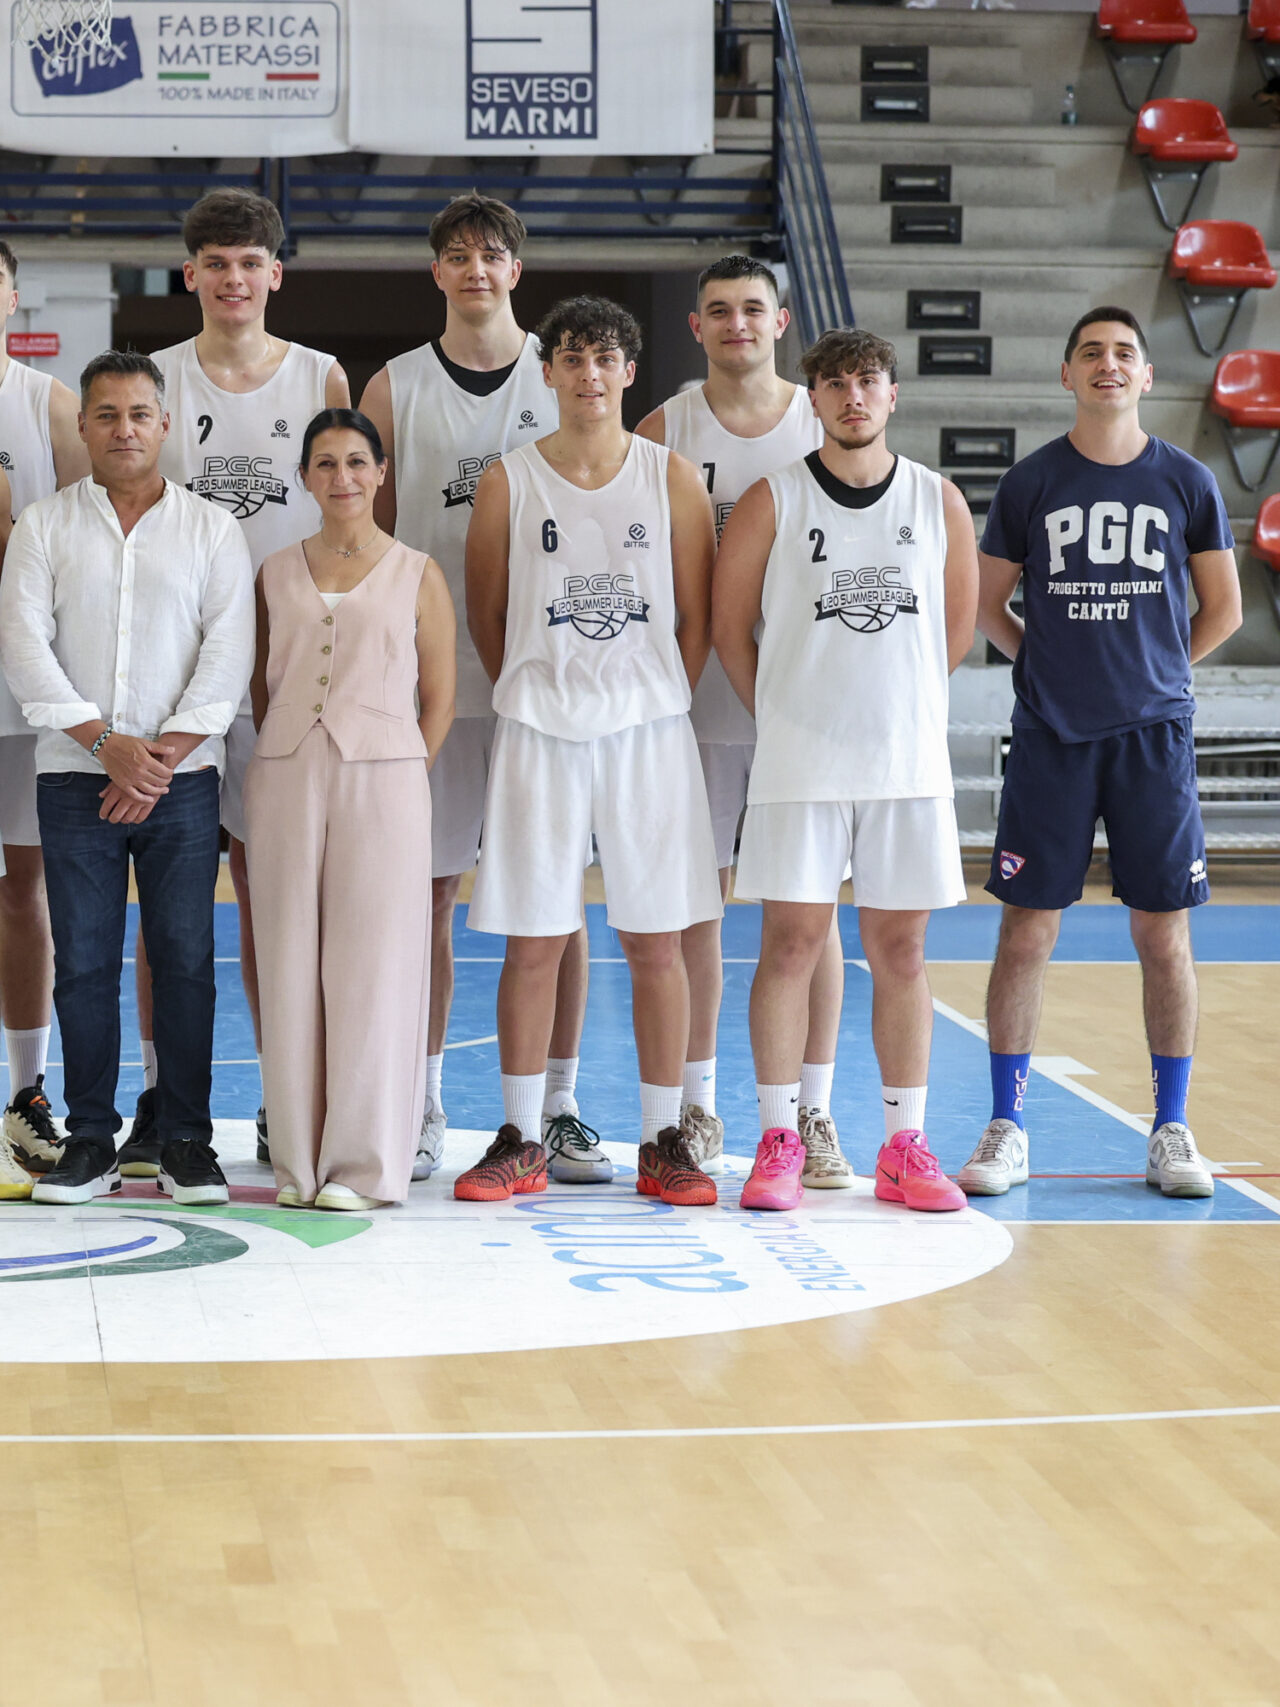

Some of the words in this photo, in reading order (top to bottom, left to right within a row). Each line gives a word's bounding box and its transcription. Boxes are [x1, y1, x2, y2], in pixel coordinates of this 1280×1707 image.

[158, 15, 319, 38] FABBRICA
[158, 44, 319, 67] MATERASSI
[158, 86, 202, 101] 100%
[207, 86, 256, 101] MADE
[259, 86, 274, 101] IN
[277, 86, 320, 101] ITALY
[471, 77, 593, 104] SEVESO
[471, 106, 593, 135] MARMI
[203, 456, 273, 479] PGC
[702, 462, 716, 494] 7
[193, 480, 210, 492] U20
[210, 478, 249, 491] SUMMER
[249, 479, 282, 495] LEAGUE
[450, 483, 468, 497] U20
[541, 518, 559, 554] 6
[623, 541, 651, 549] BITRE
[808, 528, 827, 563] 2
[1044, 501, 1170, 576] PGC
[563, 573, 635, 598] PGC
[831, 566, 902, 592] PGC
[1047, 581, 1106, 596] PROGETTO
[1110, 580, 1163, 595] GIOVANI
[554, 601, 572, 615] U20
[573, 597, 612, 611] SUMMER
[613, 597, 643, 612] LEAGUE
[823, 595, 839, 609] U20
[840, 591, 879, 605] SUMMER
[880, 590, 912, 605] LEAGUE
[1068, 598, 1130, 621] CANTÙ
[753, 1233, 867, 1291] ENERGIA
